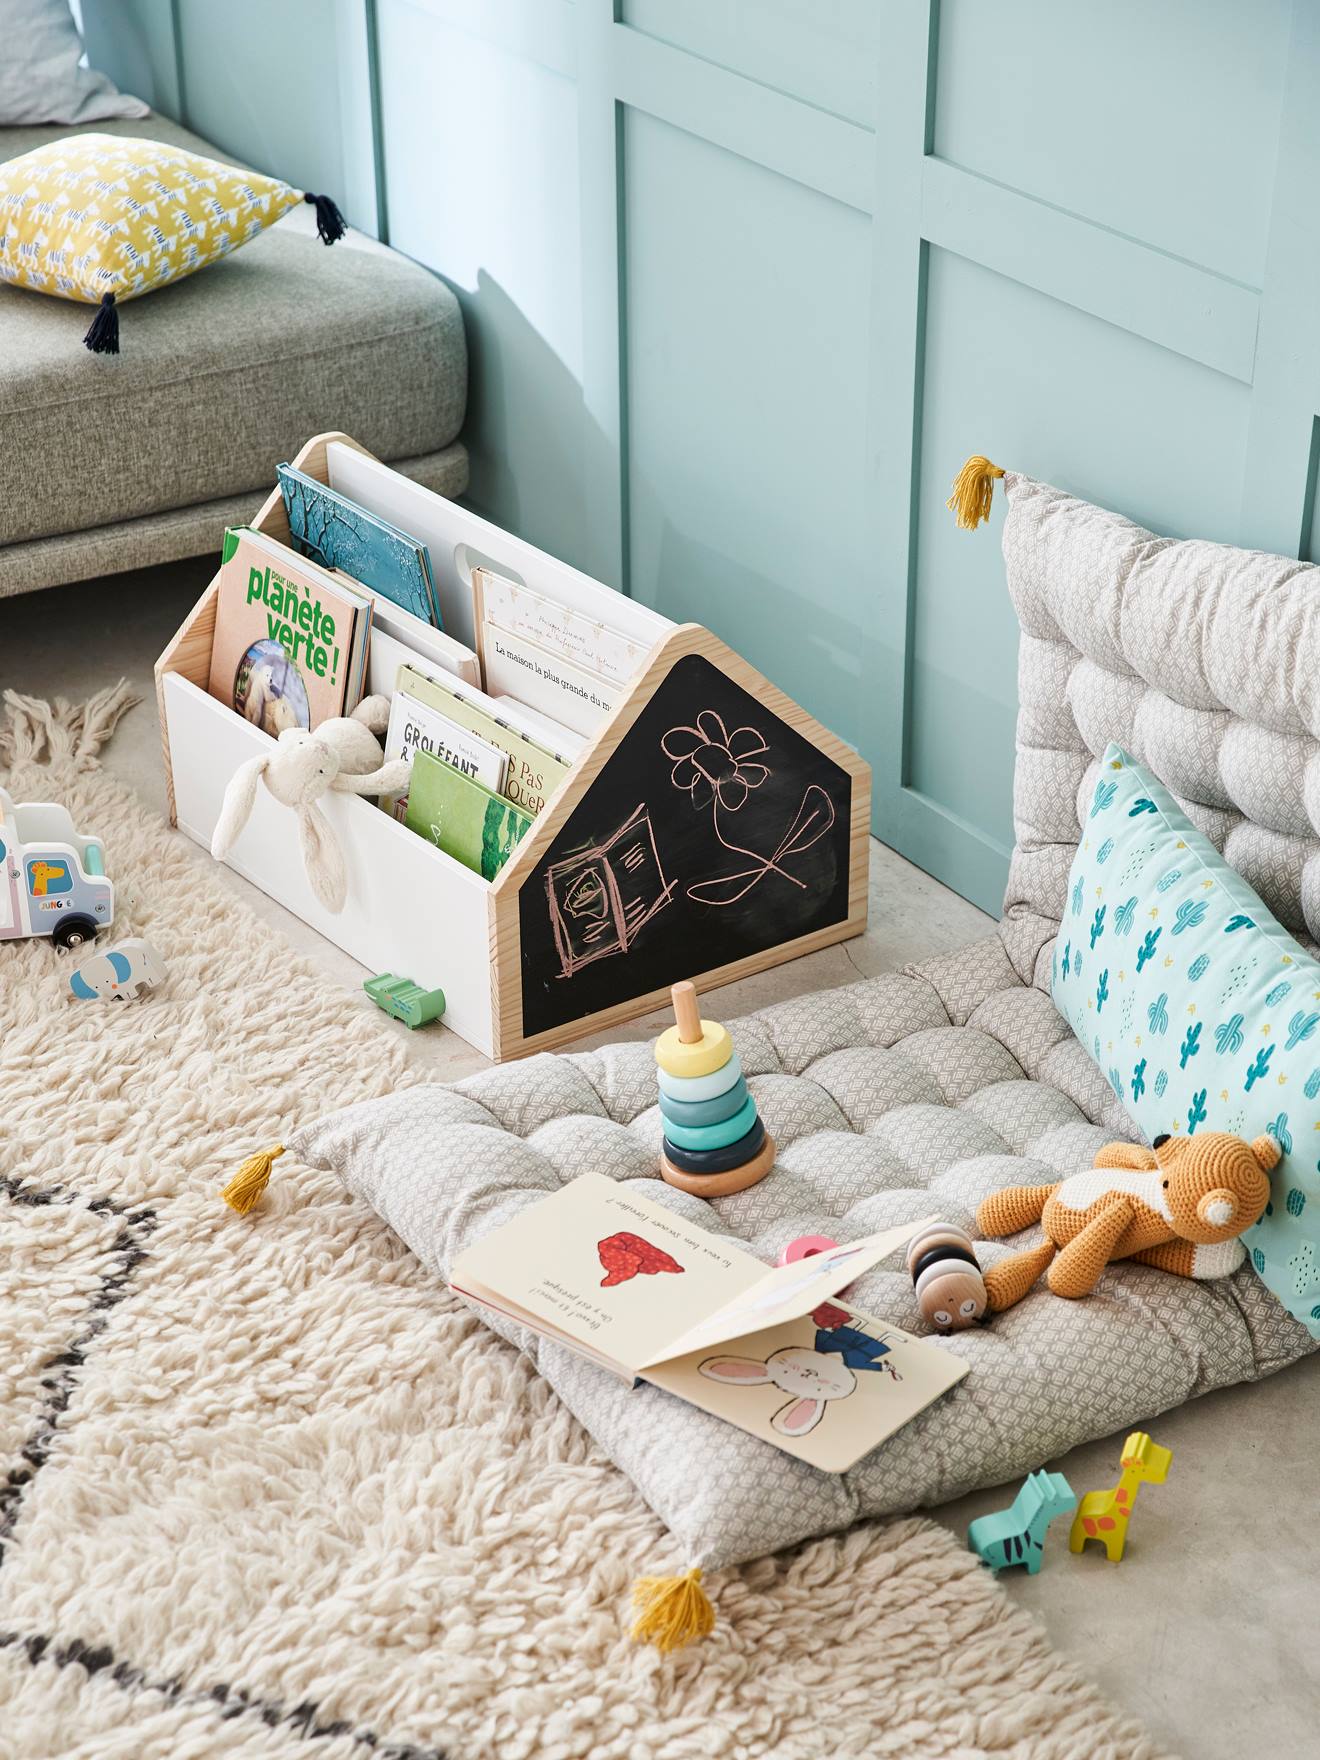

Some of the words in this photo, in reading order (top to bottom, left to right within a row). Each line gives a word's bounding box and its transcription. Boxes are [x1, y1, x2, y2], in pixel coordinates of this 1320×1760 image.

[272, 570, 286, 586] pour
[286, 579, 298, 593] une
[246, 566, 335, 646] planète
[495, 642, 505, 657] La
[506, 651, 534, 670] maison
[534, 662, 543, 675] la
[543, 669, 560, 684] plus
[560, 680, 589, 700] grande
[590, 693, 601, 706] du
[602, 702, 613, 712] m
[41, 899, 72, 910] JUNGE
